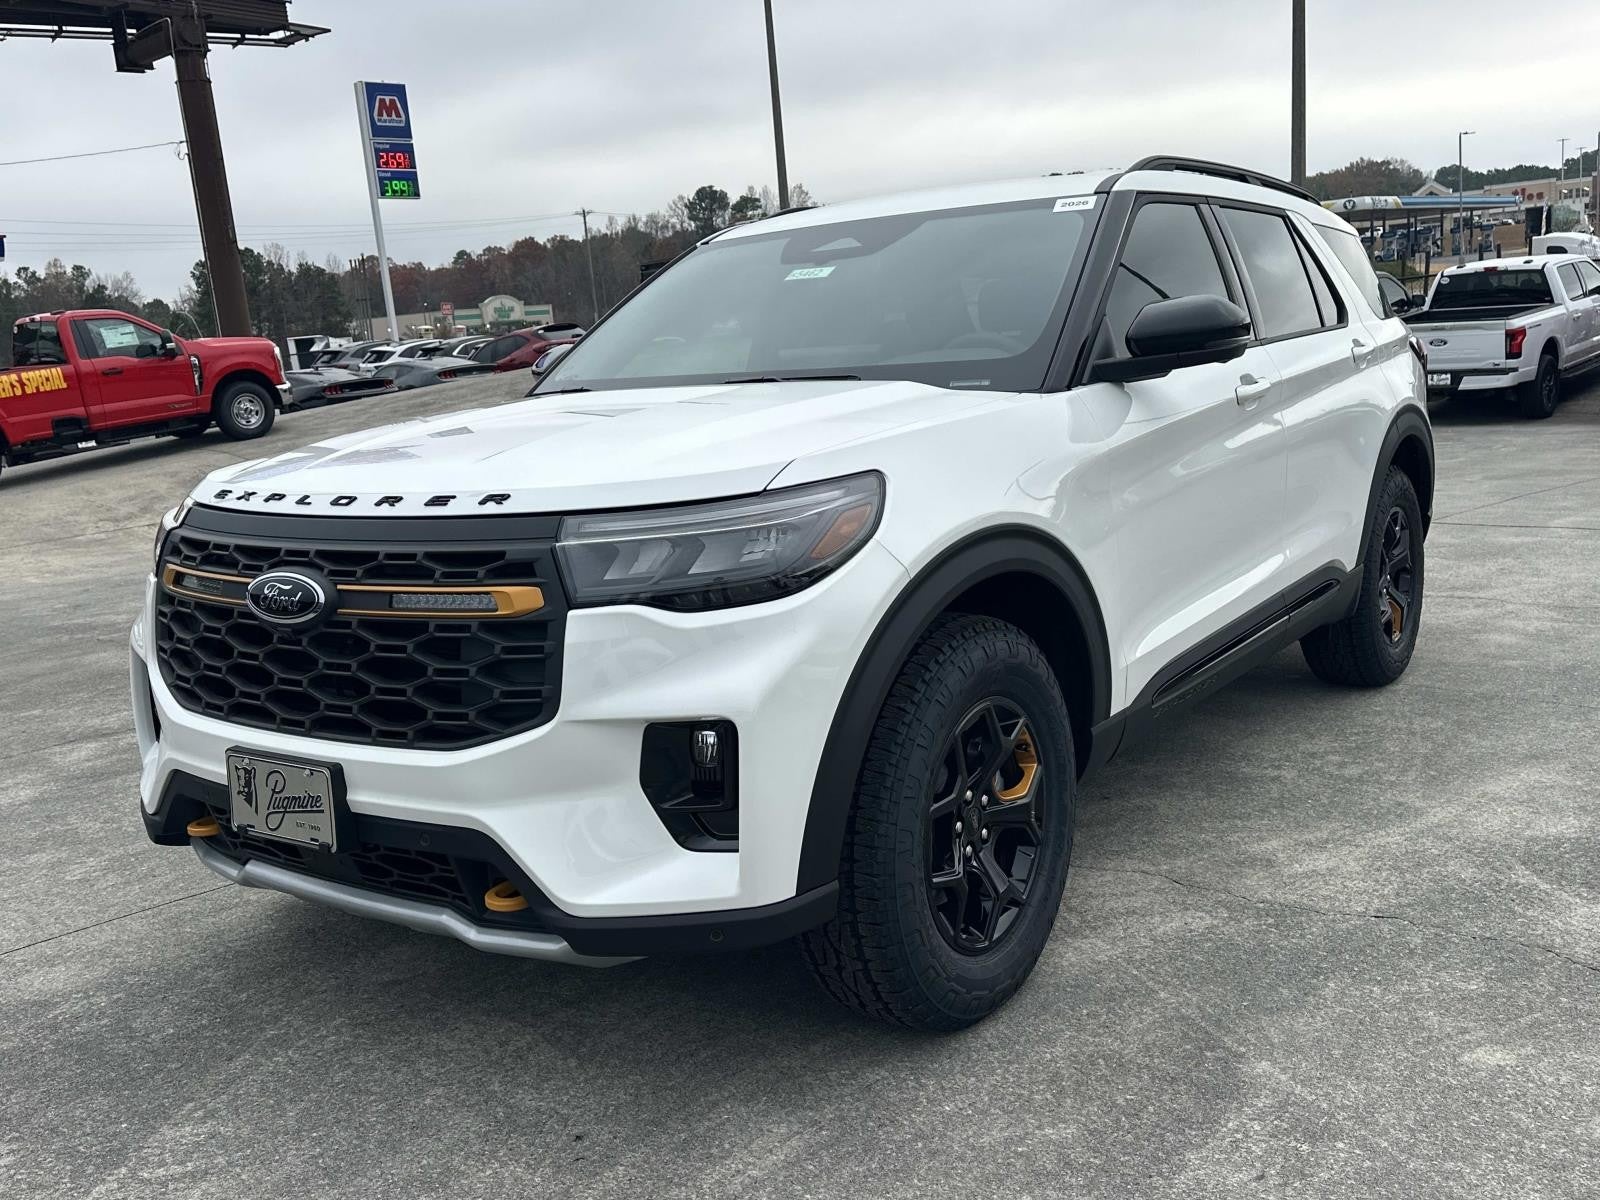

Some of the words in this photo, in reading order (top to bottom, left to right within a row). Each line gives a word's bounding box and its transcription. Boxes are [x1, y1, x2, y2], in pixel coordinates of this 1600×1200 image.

[1060, 200, 1089, 208] 2026
[21, 367, 68, 394] SPECIAL
[213, 489, 512, 507] EXPLORER
[260, 582, 302, 611] Ford
[264, 769, 325, 832] Pugmire
